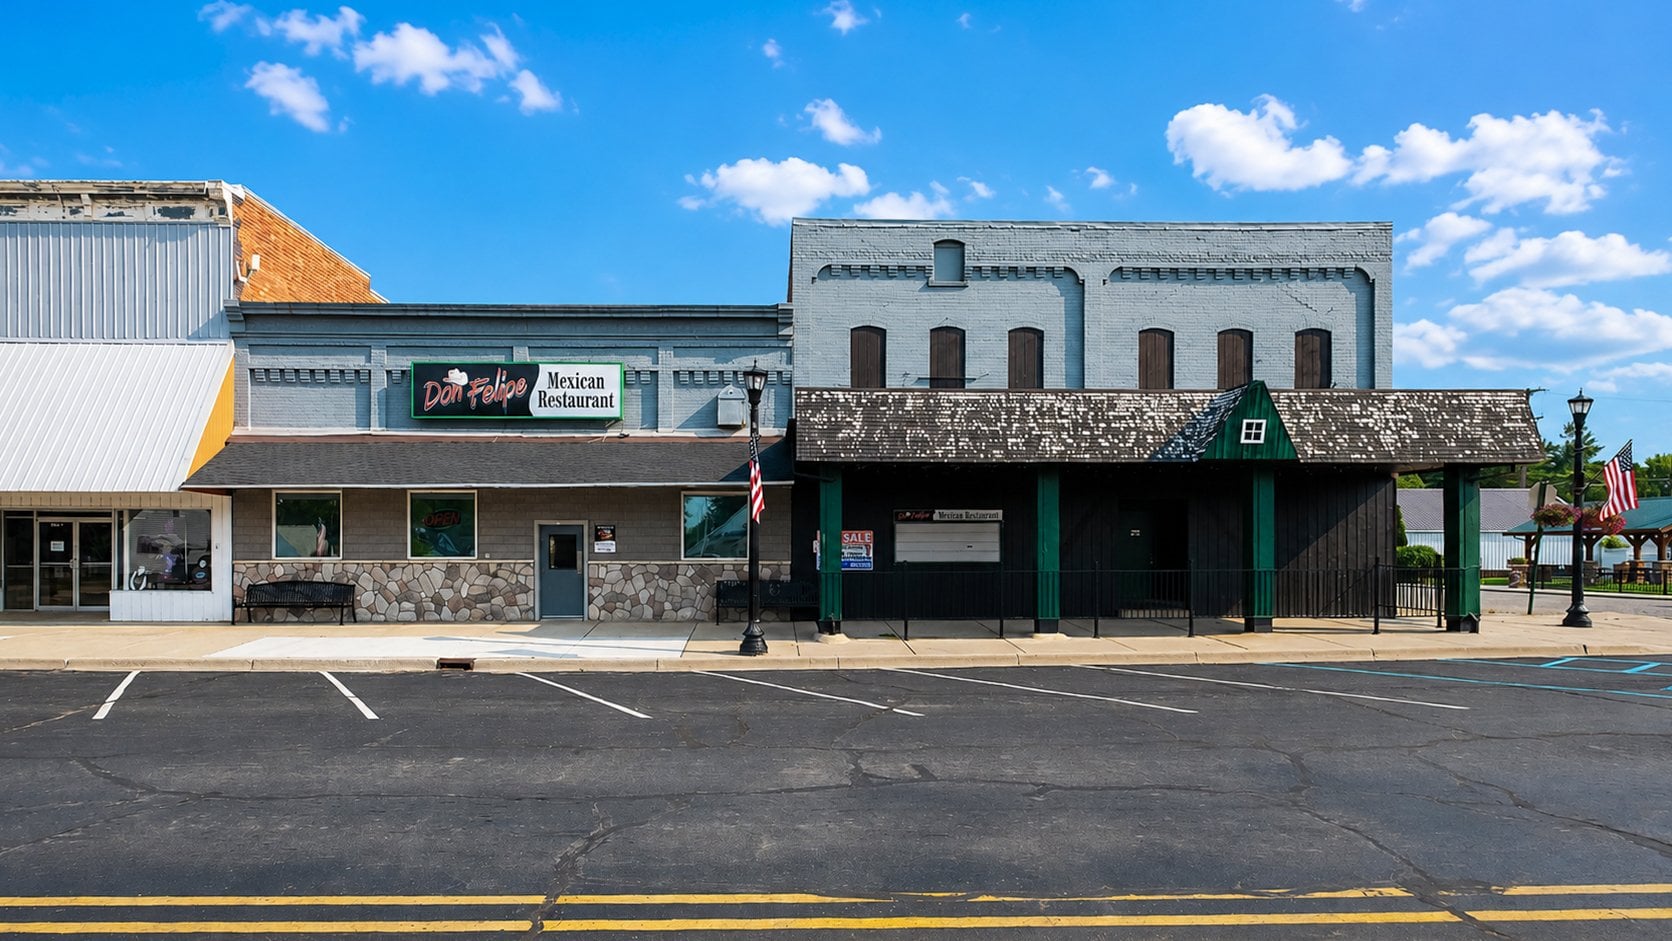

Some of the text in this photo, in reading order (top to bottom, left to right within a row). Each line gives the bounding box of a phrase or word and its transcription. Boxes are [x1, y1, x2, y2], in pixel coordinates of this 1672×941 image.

[547, 371, 605, 390] Mexican
[423, 367, 528, 415] Don Felipe
[538, 390, 615, 409] Restaurant
[425, 511, 460, 526] OPEN
[938, 511, 999, 519] Mexican Restaurant
[843, 533, 871, 543] SALE
